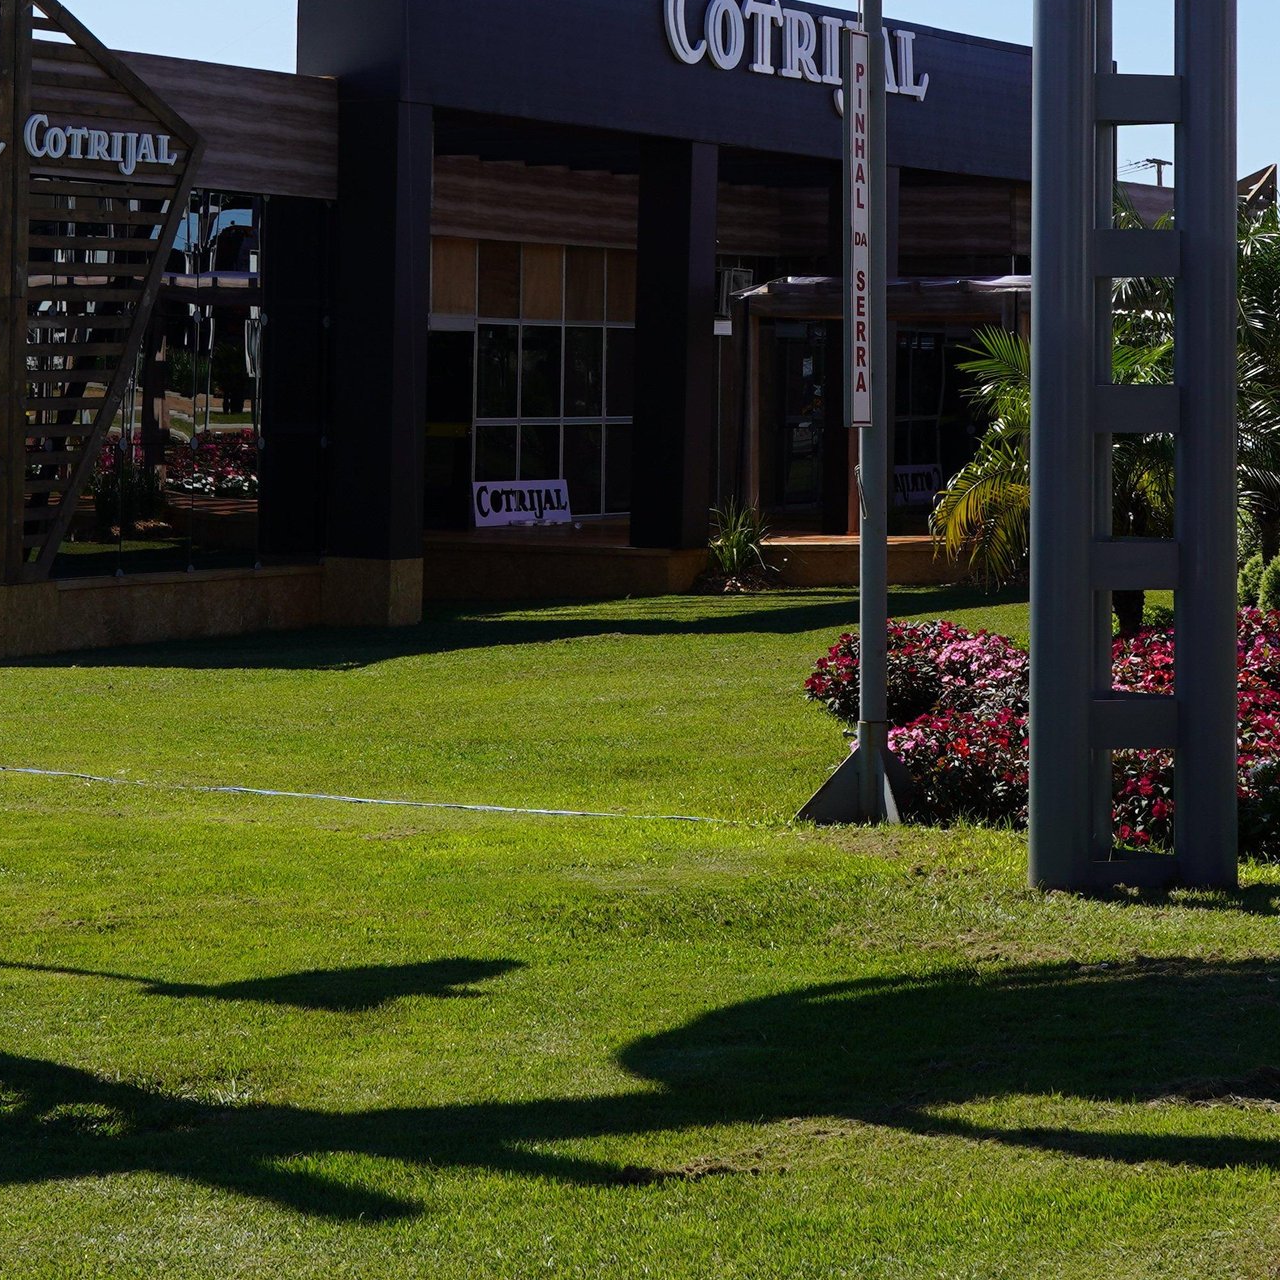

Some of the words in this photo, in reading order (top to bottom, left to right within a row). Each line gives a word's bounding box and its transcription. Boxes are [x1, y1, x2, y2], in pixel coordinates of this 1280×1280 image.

[23, 113, 178, 176] COTRIJAL
[855, 63, 865, 210] PINHAL
[854, 233, 867, 248] DA
[855, 271, 867, 393] SERRA
[476, 485, 568, 518] COTRIJAL
